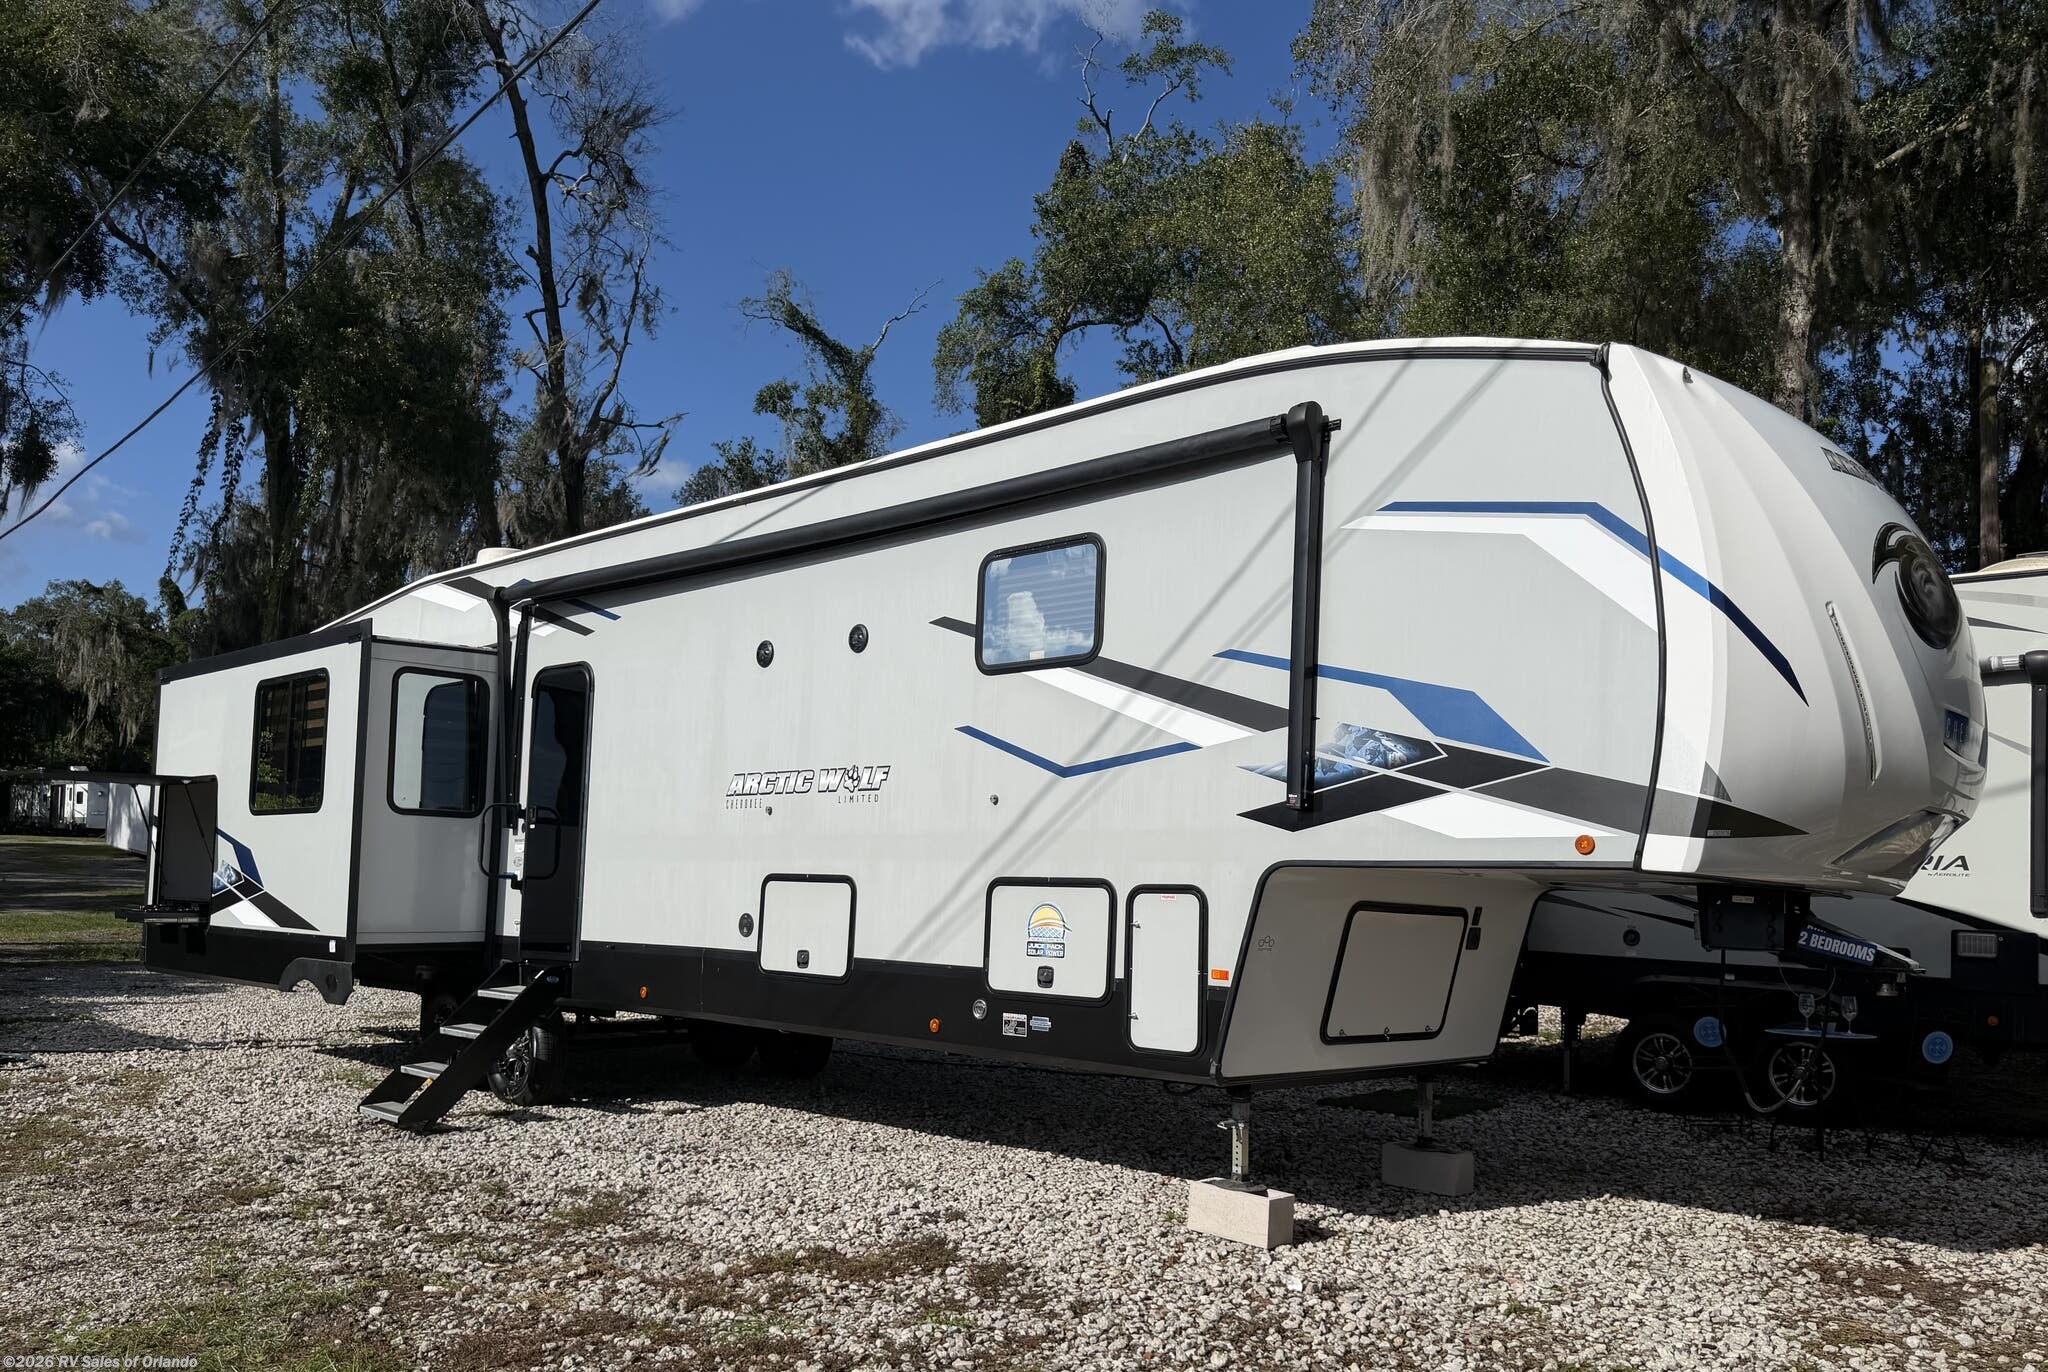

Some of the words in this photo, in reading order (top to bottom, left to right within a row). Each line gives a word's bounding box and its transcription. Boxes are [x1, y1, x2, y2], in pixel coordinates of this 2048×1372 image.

[726, 769, 815, 797] ARCTIC
[838, 794, 879, 804] LIMITED
[1798, 931, 1808, 945] 2
[1809, 933, 1876, 962] BEDROOMS
